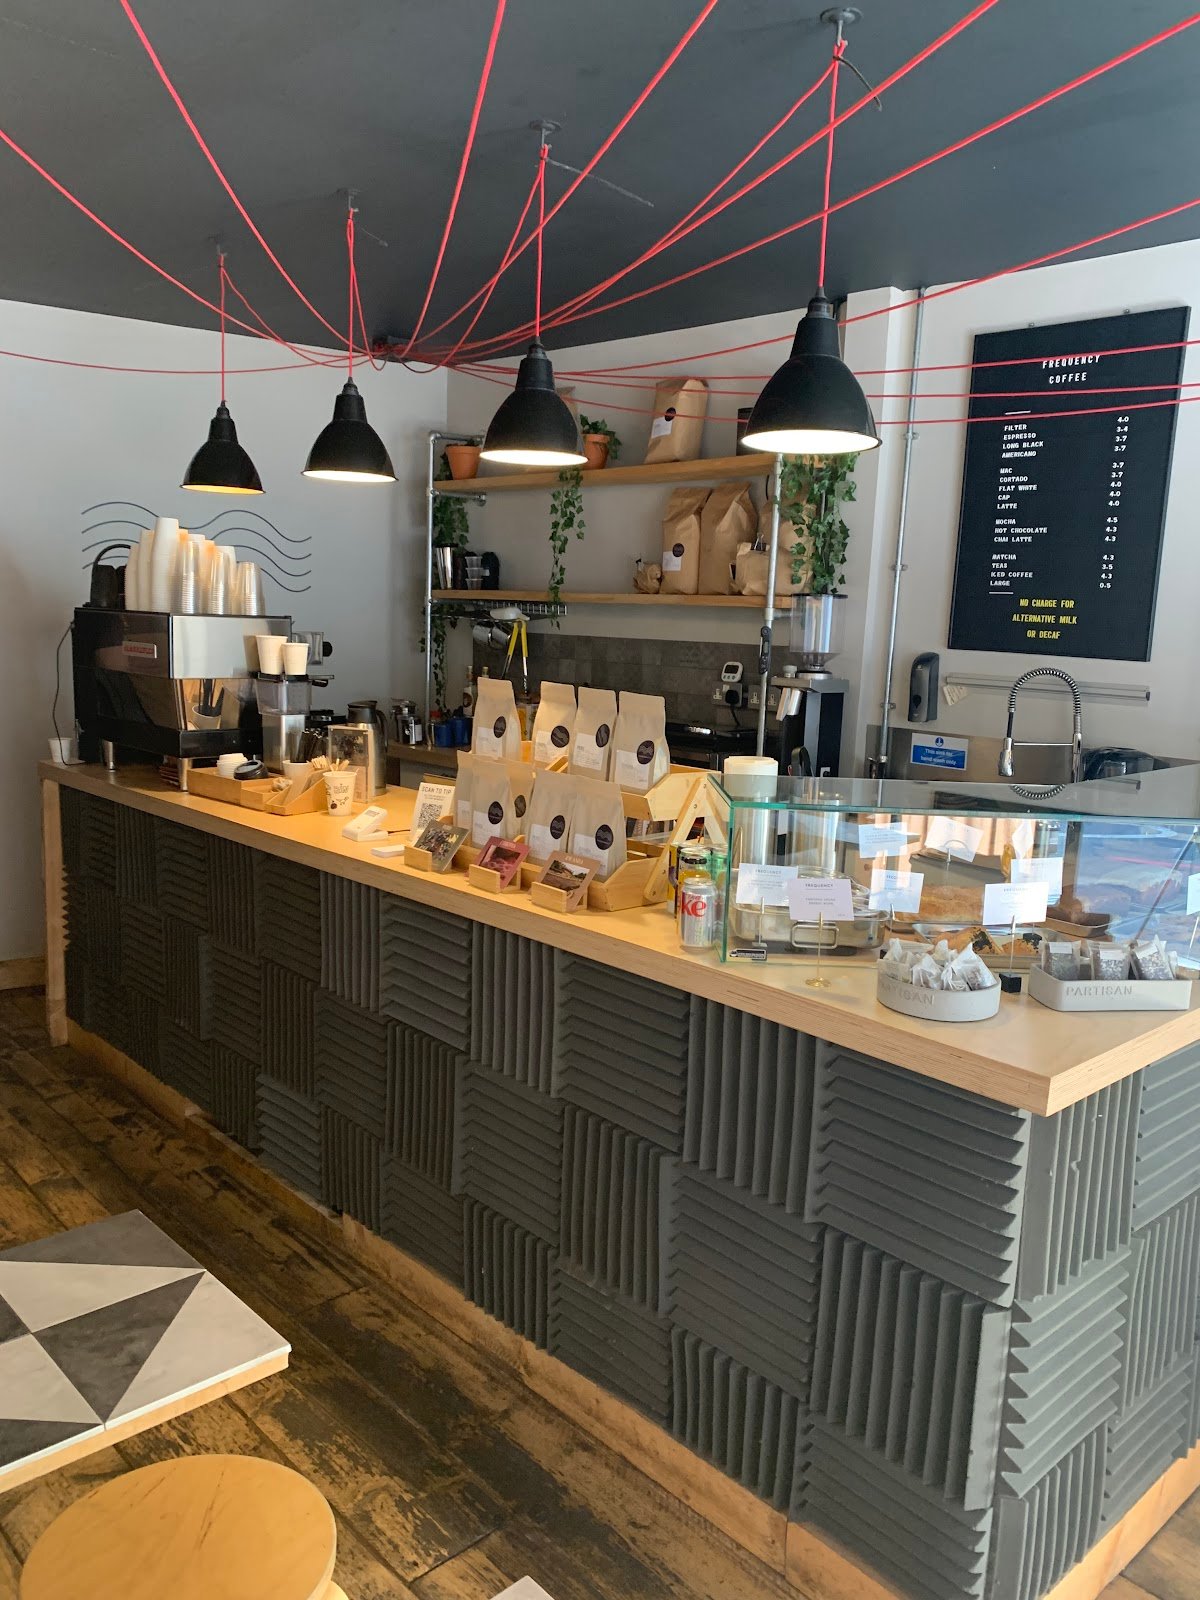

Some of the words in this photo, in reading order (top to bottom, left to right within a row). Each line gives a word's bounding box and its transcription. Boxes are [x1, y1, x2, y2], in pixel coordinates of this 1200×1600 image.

[1042, 354, 1101, 369] FREQUENCY
[1049, 372, 1088, 384] COFFEE
[1004, 424, 1027, 432] FILTER
[1003, 432, 1036, 440] ESPRESSO
[1001, 451, 1037, 459] AMERICANO
[1019, 599, 1029, 607] NO
[1031, 599, 1058, 608] CHARGE
[1060, 600, 1075, 609] FOR
[1012, 614, 1056, 624] ALTERNATIVE
[1059, 616, 1078, 624] MILK
[1026, 630, 1036, 638] OR
[1039, 630, 1061, 640] DECAF
[681, 891, 707, 917] ke
[1065, 985, 1133, 997] PARTISAN
